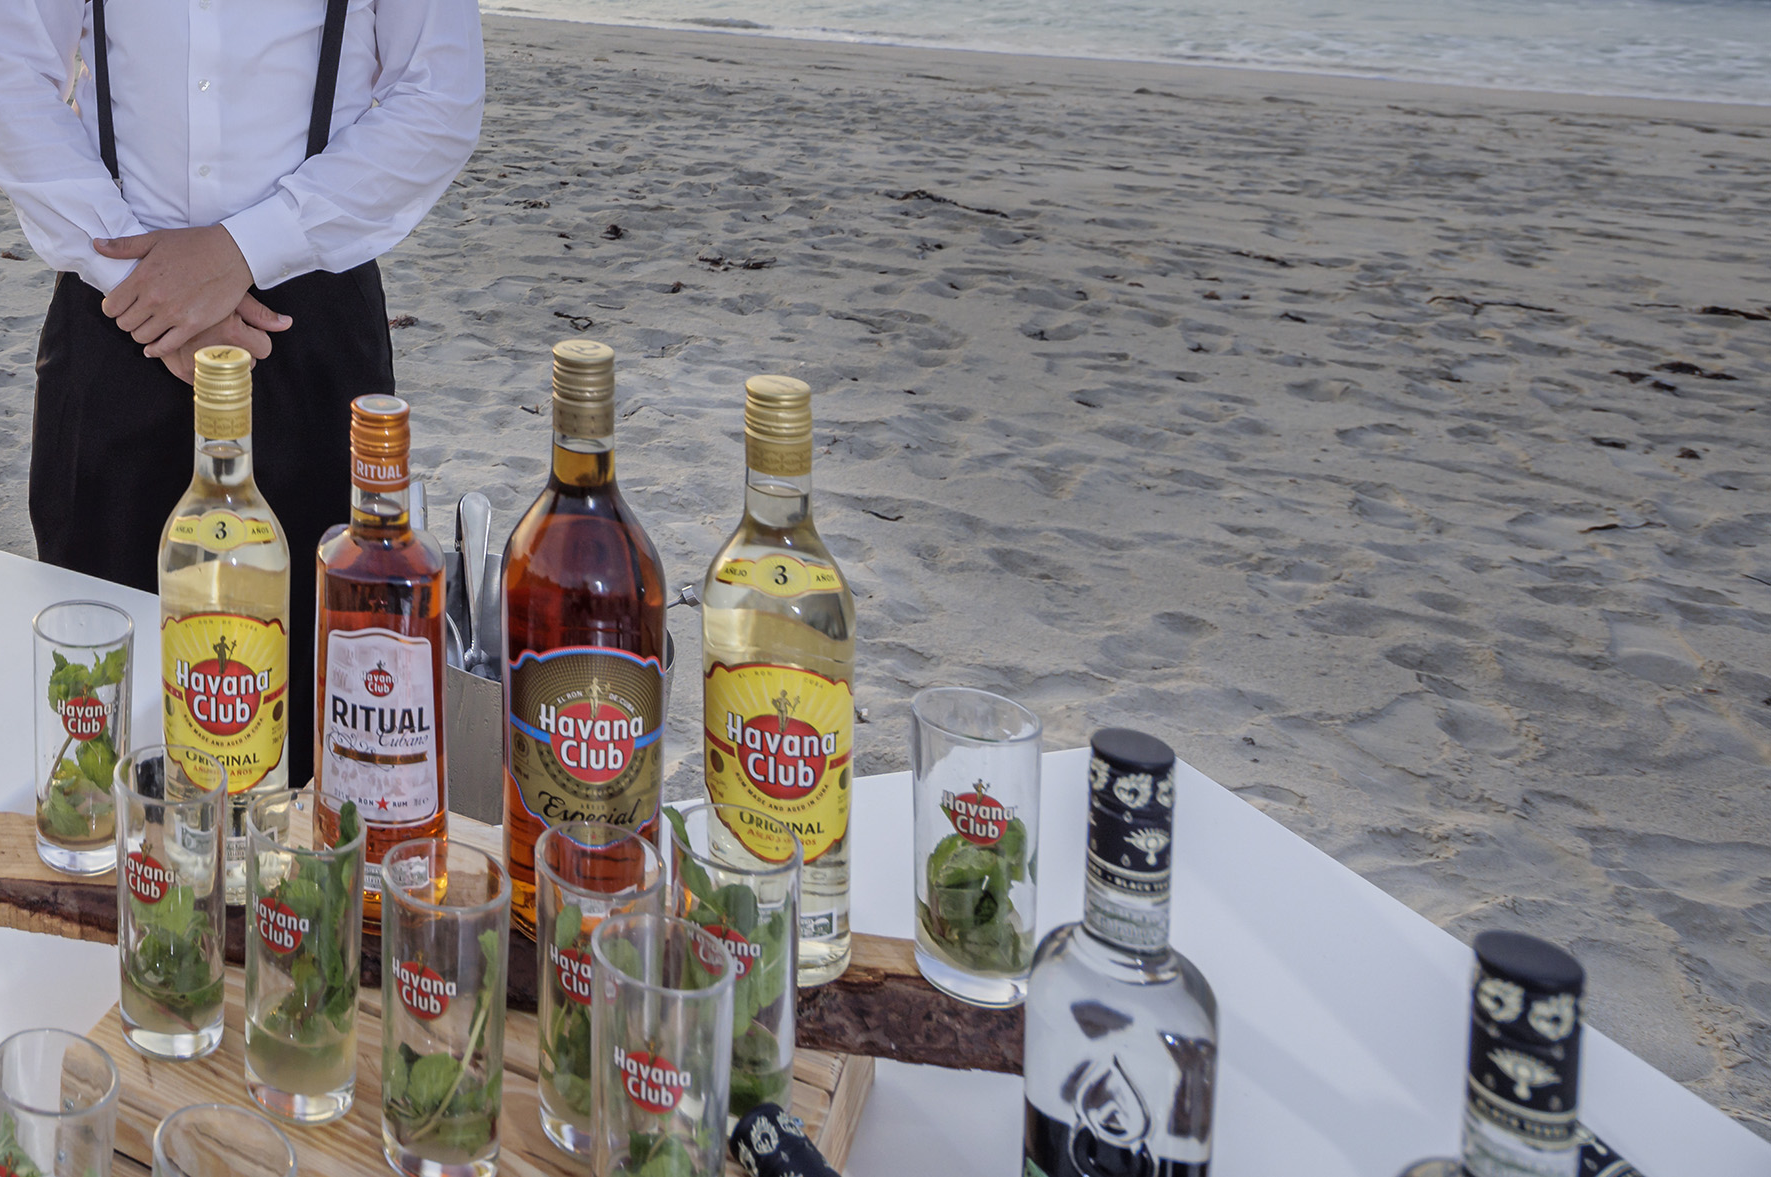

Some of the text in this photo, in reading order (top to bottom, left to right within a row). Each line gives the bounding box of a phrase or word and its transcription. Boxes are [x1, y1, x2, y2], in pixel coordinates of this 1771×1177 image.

[357, 460, 402, 479] RITUAL
[215, 521, 227, 540] 3
[251, 525, 269, 535] AÑOS
[724, 567, 747, 577] AÑEJO
[774, 565, 788, 585] 3
[175, 658, 270, 696] Havana
[368, 682, 390, 693] Club
[57, 699, 112, 718] Havana
[193, 693, 251, 723] Club
[566, 690, 584, 699] RON
[67, 718, 101, 733] Club
[331, 694, 430, 734] RITUAL
[539, 703, 643, 742] Havana
[376, 728, 429, 748] Cubano
[725, 711, 836, 758] Havana
[560, 739, 624, 770] Club
[747, 752, 816, 788] Club
[358, 797, 374, 807] RON
[392, 800, 408, 808] RUM
[538, 790, 642, 827] Especial
[942, 789, 1015, 821] Havana
[956, 815, 1000, 839] Club
[128, 872, 161, 899] Club
[252, 892, 310, 933] Havana
[260, 919, 294, 948] Club
[392, 955, 457, 997] Havana
[550, 943, 592, 979] Hava
[402, 984, 441, 1014] Club
[561, 971, 589, 997] Clu
[614, 1045, 691, 1087] Havana
[627, 1076, 674, 1108] Club
